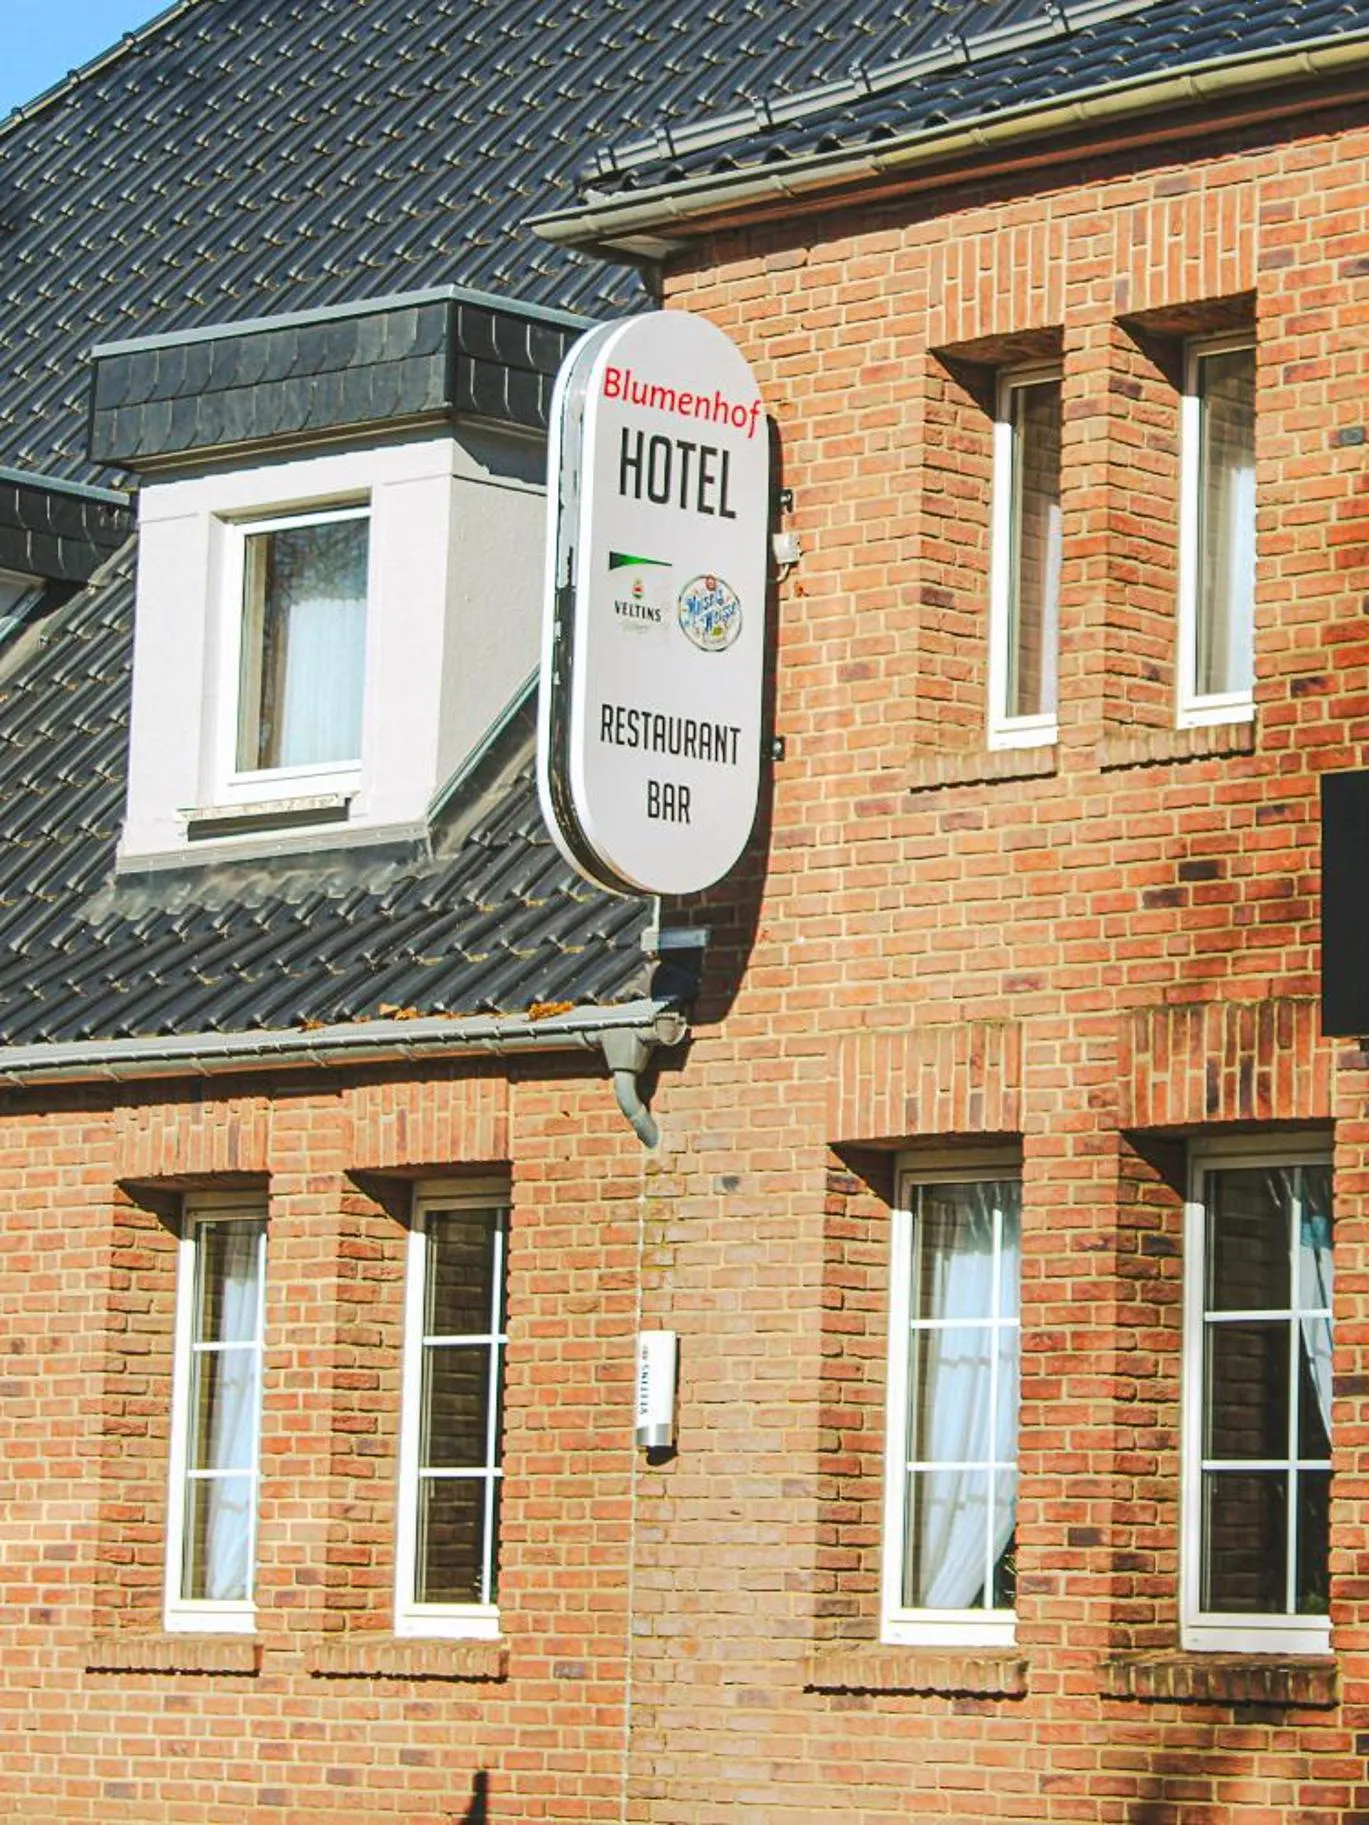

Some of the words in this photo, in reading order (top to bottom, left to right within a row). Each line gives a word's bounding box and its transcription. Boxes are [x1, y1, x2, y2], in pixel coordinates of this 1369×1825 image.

[603, 366, 761, 439] Blumenhof
[619, 427, 736, 519] HOTEL
[614, 600, 661, 622] VELTINS
[601, 703, 741, 766] RESTAURANT
[647, 780, 692, 825] BAR
